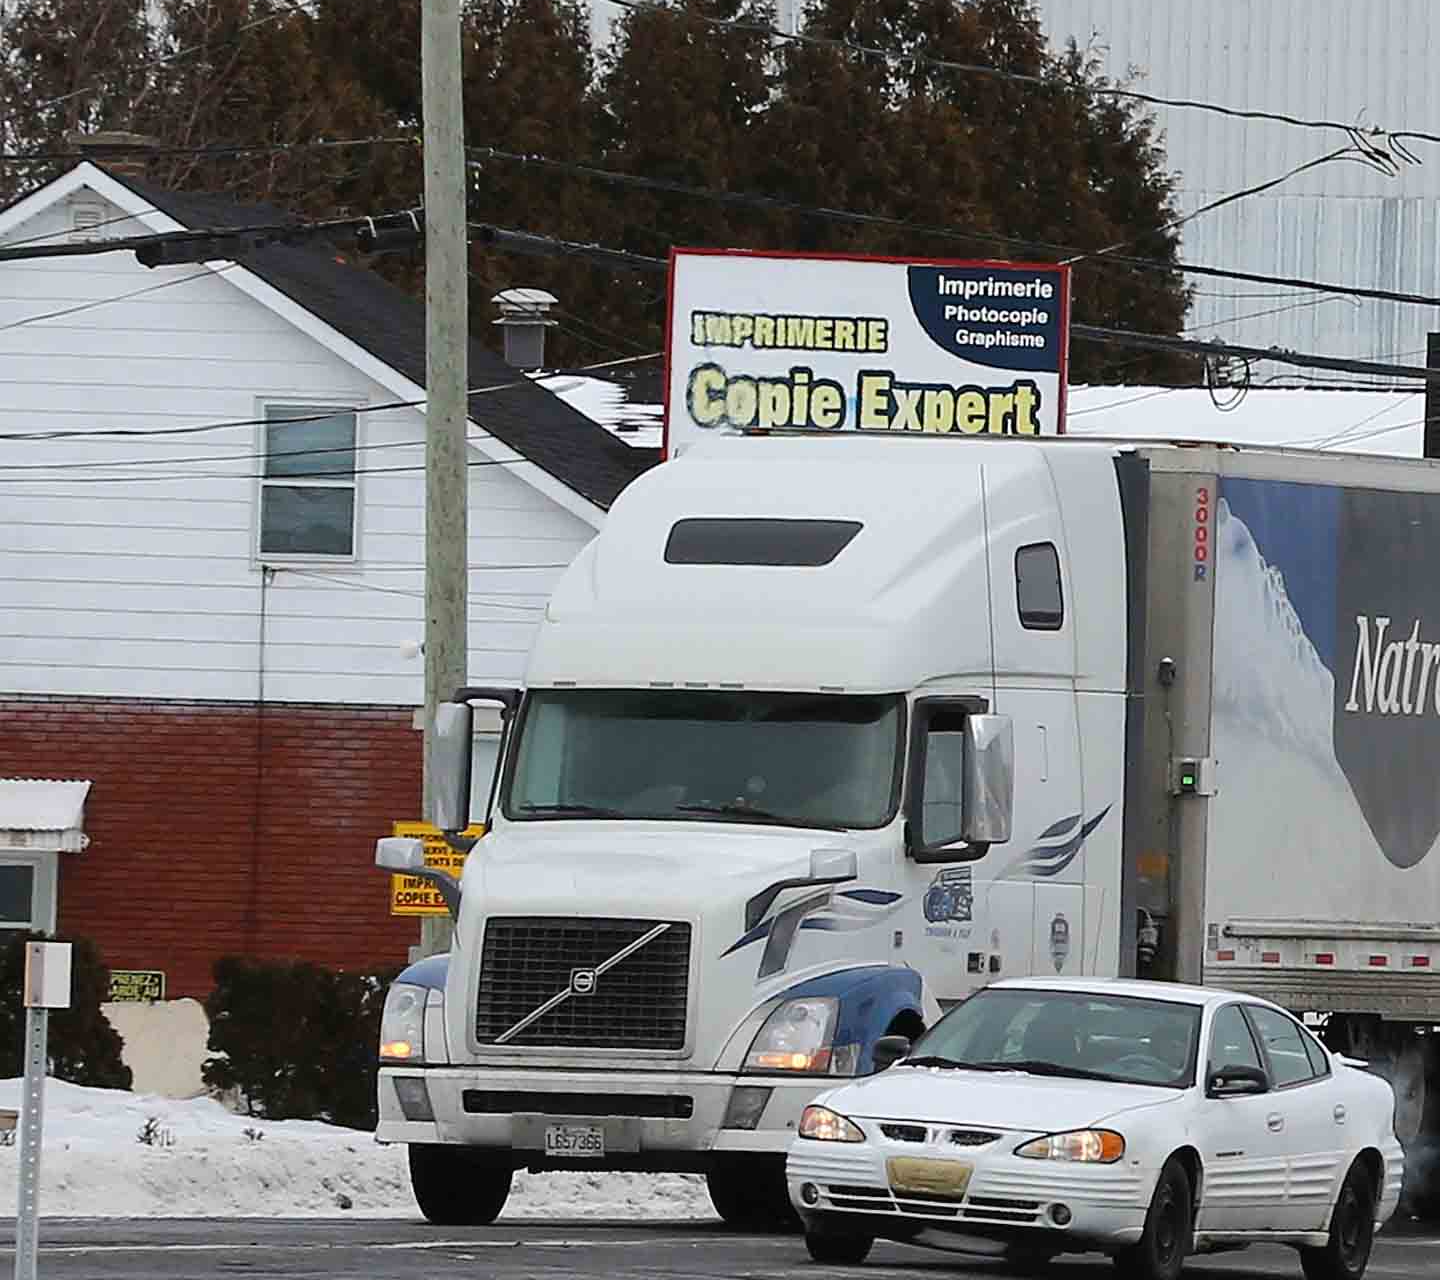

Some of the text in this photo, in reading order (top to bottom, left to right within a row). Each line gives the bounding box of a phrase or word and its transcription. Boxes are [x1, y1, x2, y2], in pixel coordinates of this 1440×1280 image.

[938, 274, 1053, 300] Imprimerie
[944, 304, 1049, 326] Photocopie
[691, 310, 888, 353] IMPRIMERIE
[955, 329, 1045, 348] Graphisme
[687, 363, 1041, 436] Copie Expert
[396, 891, 431, 904] COPIE
